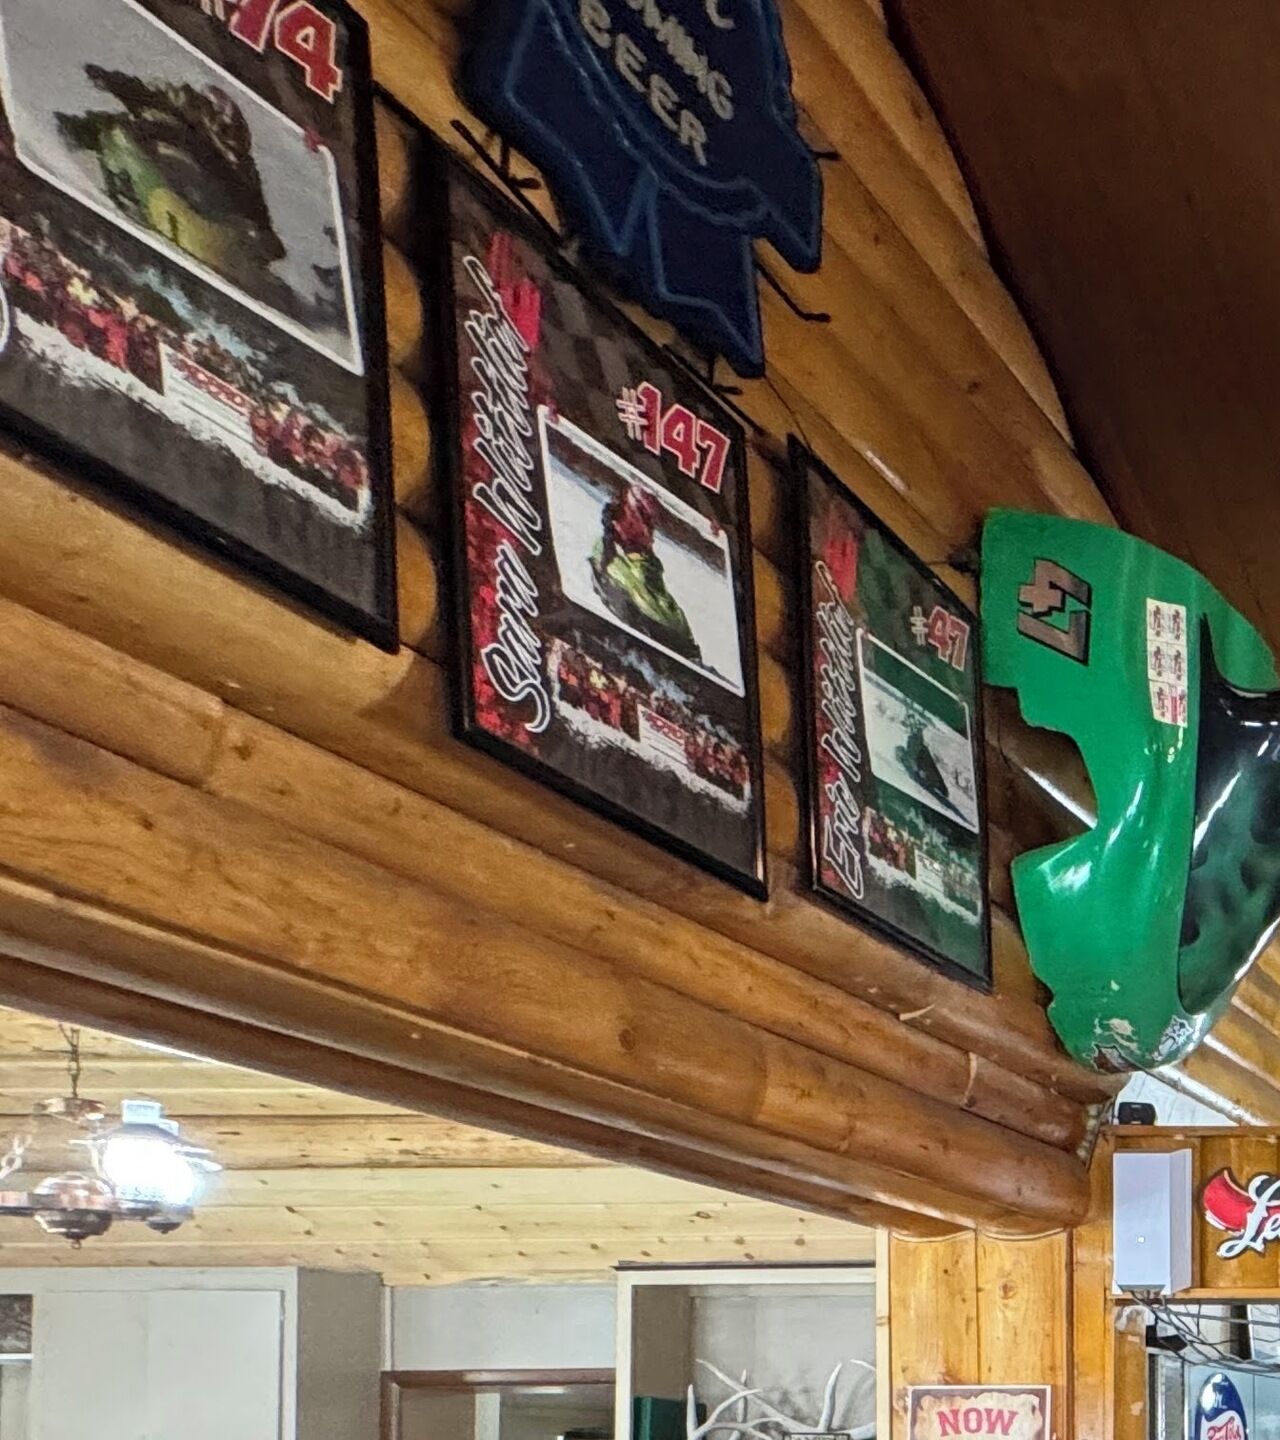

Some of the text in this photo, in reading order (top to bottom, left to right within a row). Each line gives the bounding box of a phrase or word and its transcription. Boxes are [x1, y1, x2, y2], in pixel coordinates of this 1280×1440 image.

[615, 380, 732, 495] #147
[910, 605, 971, 672] #47
[937, 1407, 1019, 1438] NOW
